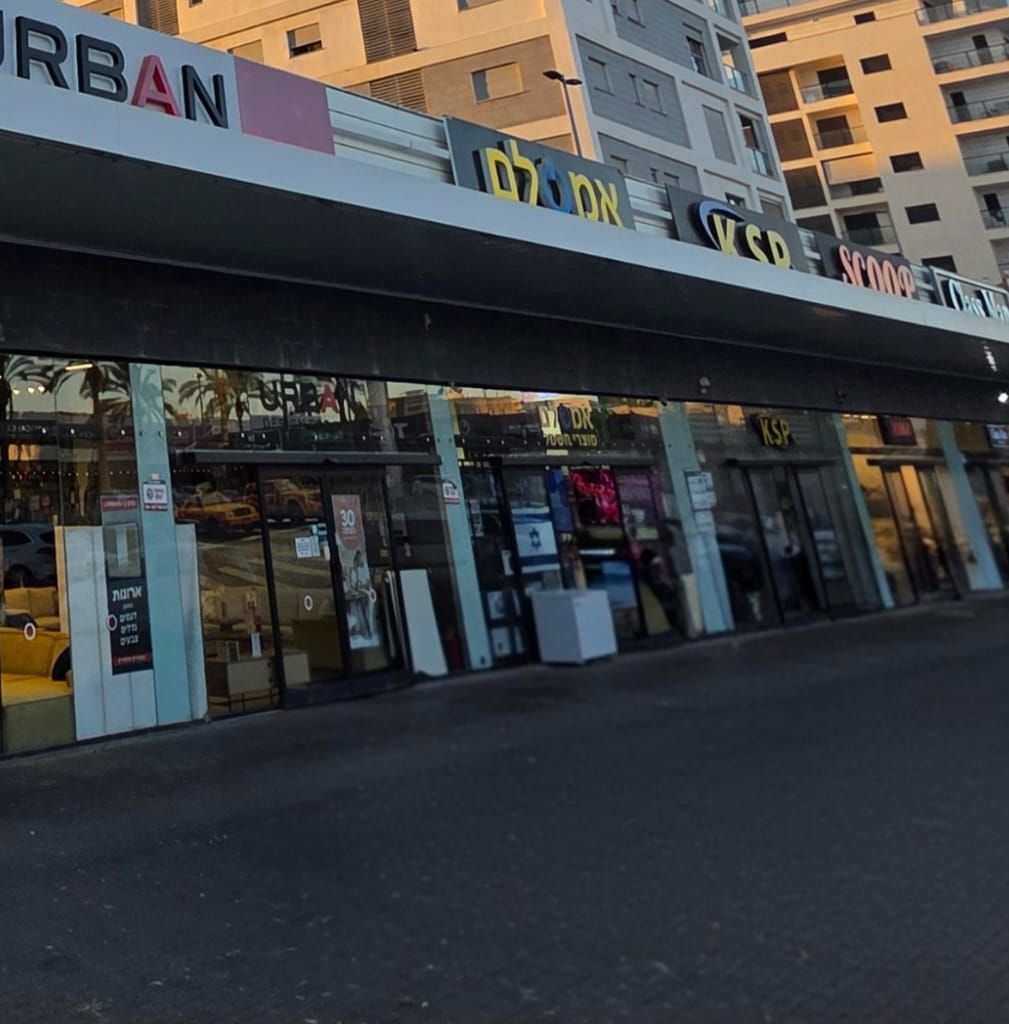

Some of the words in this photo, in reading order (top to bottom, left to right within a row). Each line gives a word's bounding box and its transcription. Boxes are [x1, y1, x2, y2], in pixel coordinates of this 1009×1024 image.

[482, 138, 624, 228] אמסלם
[711, 213, 791, 269] KSP
[838, 244, 916, 300] SCOOP
[759, 416, 790, 448] KSP
[340, 508, 356, 527] 30
